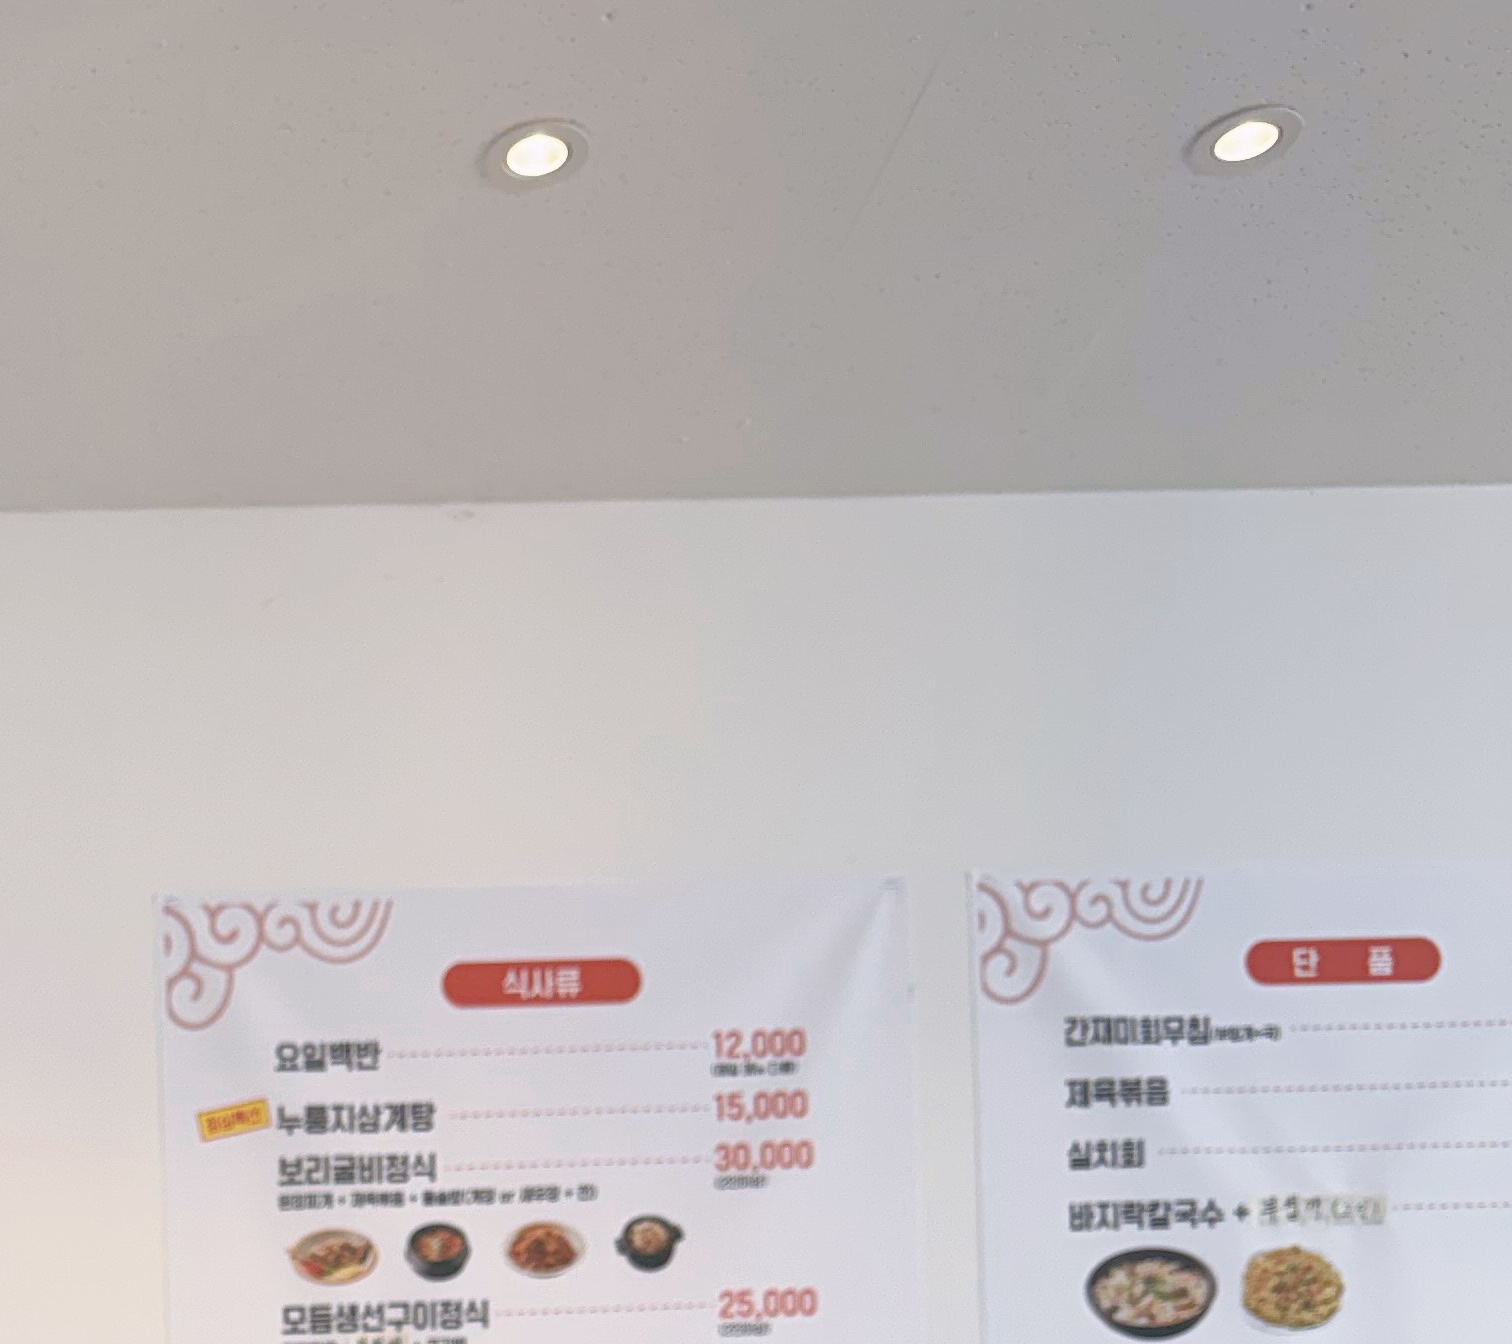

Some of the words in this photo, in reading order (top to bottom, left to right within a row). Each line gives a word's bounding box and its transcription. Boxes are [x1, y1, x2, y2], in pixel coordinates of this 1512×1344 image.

[1291, 946, 1319, 978] 단
[501, 965, 582, 1001] 식사류
[276, 1041, 381, 1072] 요일백반
[713, 1028, 806, 1062] 12,000
[1067, 1077, 1168, 1108] 제육볶음
[278, 1102, 435, 1135] 누룽지삼계탕
[715, 1089, 808, 1123] 15,000
[279, 1154, 436, 1186] 보리굴비정식
[715, 1140, 813, 1174] 30,000
[1069, 1139, 1144, 1170] 실치회
[1069, 1199, 1224, 1231] 바지락칼국수
[283, 1300, 489, 1335] 모듬생선구이정식
[719, 1288, 817, 1322] 25,000
